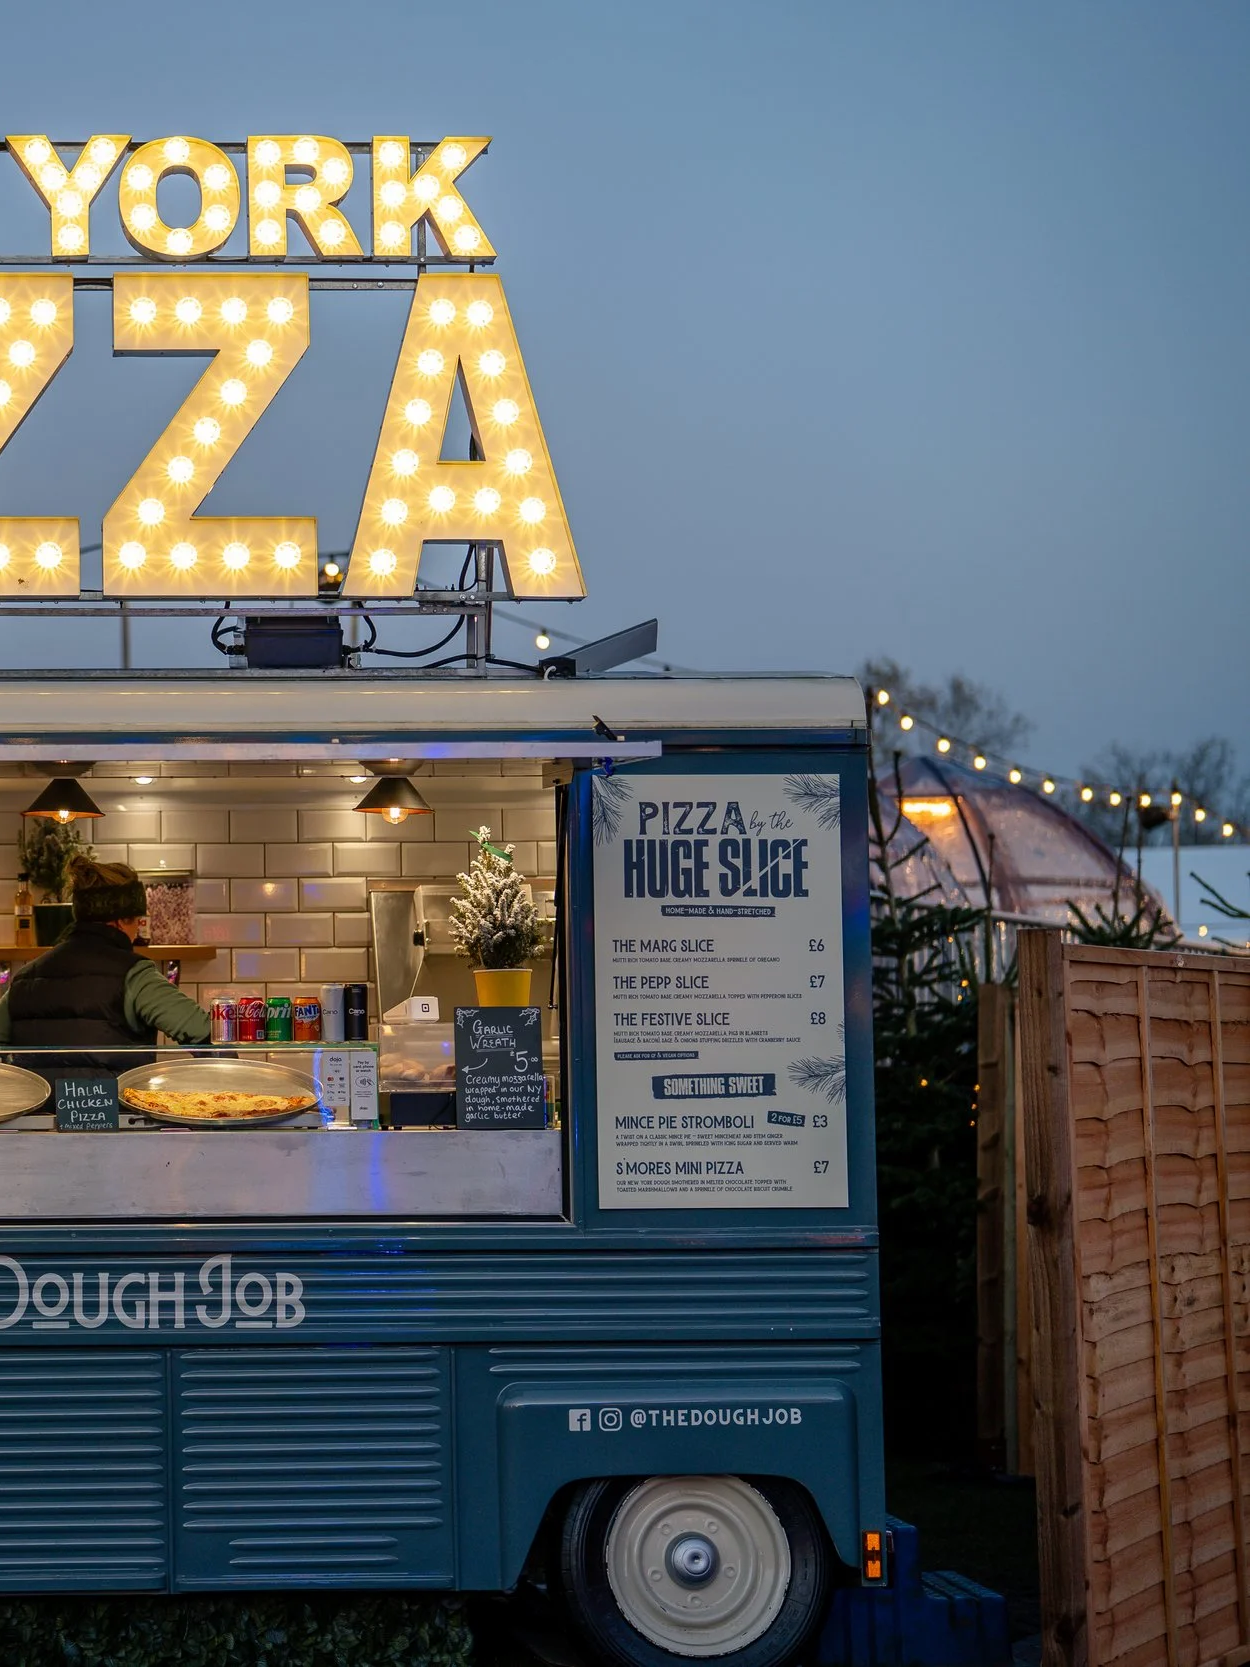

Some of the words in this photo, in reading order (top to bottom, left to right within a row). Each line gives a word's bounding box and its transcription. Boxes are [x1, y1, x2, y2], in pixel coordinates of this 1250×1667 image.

[6, 134, 497, 263] YORK
[639, 801, 747, 835] PIZZA
[749, 810, 767, 836] by
[769, 810, 794, 830] the
[623, 838, 710, 898] HUGE
[718, 838, 809, 898] SLICE
[665, 907, 707, 915] HOME-MADE
[708, 906, 715, 915] &
[716, 907, 772, 915] HAND-STRETCHED
[612, 939, 636, 953] THE
[640, 939, 677, 953] MARG
[680, 939, 714, 952] SLICE
[809, 938, 825, 952] £6
[613, 976, 637, 989] THE
[641, 976, 671, 989] PEPP
[675, 975, 709, 989] SLICE
[810, 975, 825, 988] £7
[266, 1002, 291, 1021] prit
[810, 1012, 826, 1025] £8
[613, 1013, 637, 1026] THE
[642, 1013, 692, 1026] FESTIVE
[696, 1012, 730, 1026] SLICE
[465, 1085, 496, 1095] wrapped
[527, 1085, 542, 1094] NY
[663, 1077, 726, 1096] SOMETHING
[728, 1076, 764, 1094] SWEET
[57, 1098, 113, 1109] CHICKEN
[495, 1095, 540, 1103] smothered
[477, 1103, 535, 1112] home-made
[70, 1110, 106, 1123] PIZZA
[464, 1112, 490, 1122] garlic
[615, 1116, 654, 1129] MINCE
[658, 1115, 677, 1129] PIE
[681, 1115, 754, 1129] STROMBOLI
[771, 1113, 777, 1122] 2
[778, 1115, 791, 1123] FOR
[792, 1115, 803, 1125] £5
[812, 1114, 828, 1128] £3
[675, 1161, 702, 1175] MINI
[706, 1161, 744, 1174] PIZZA
[813, 1160, 829, 1174] £7
[196, 1253, 306, 1329] JOB
[630, 1407, 802, 1428] @THEDOUGHJOB
